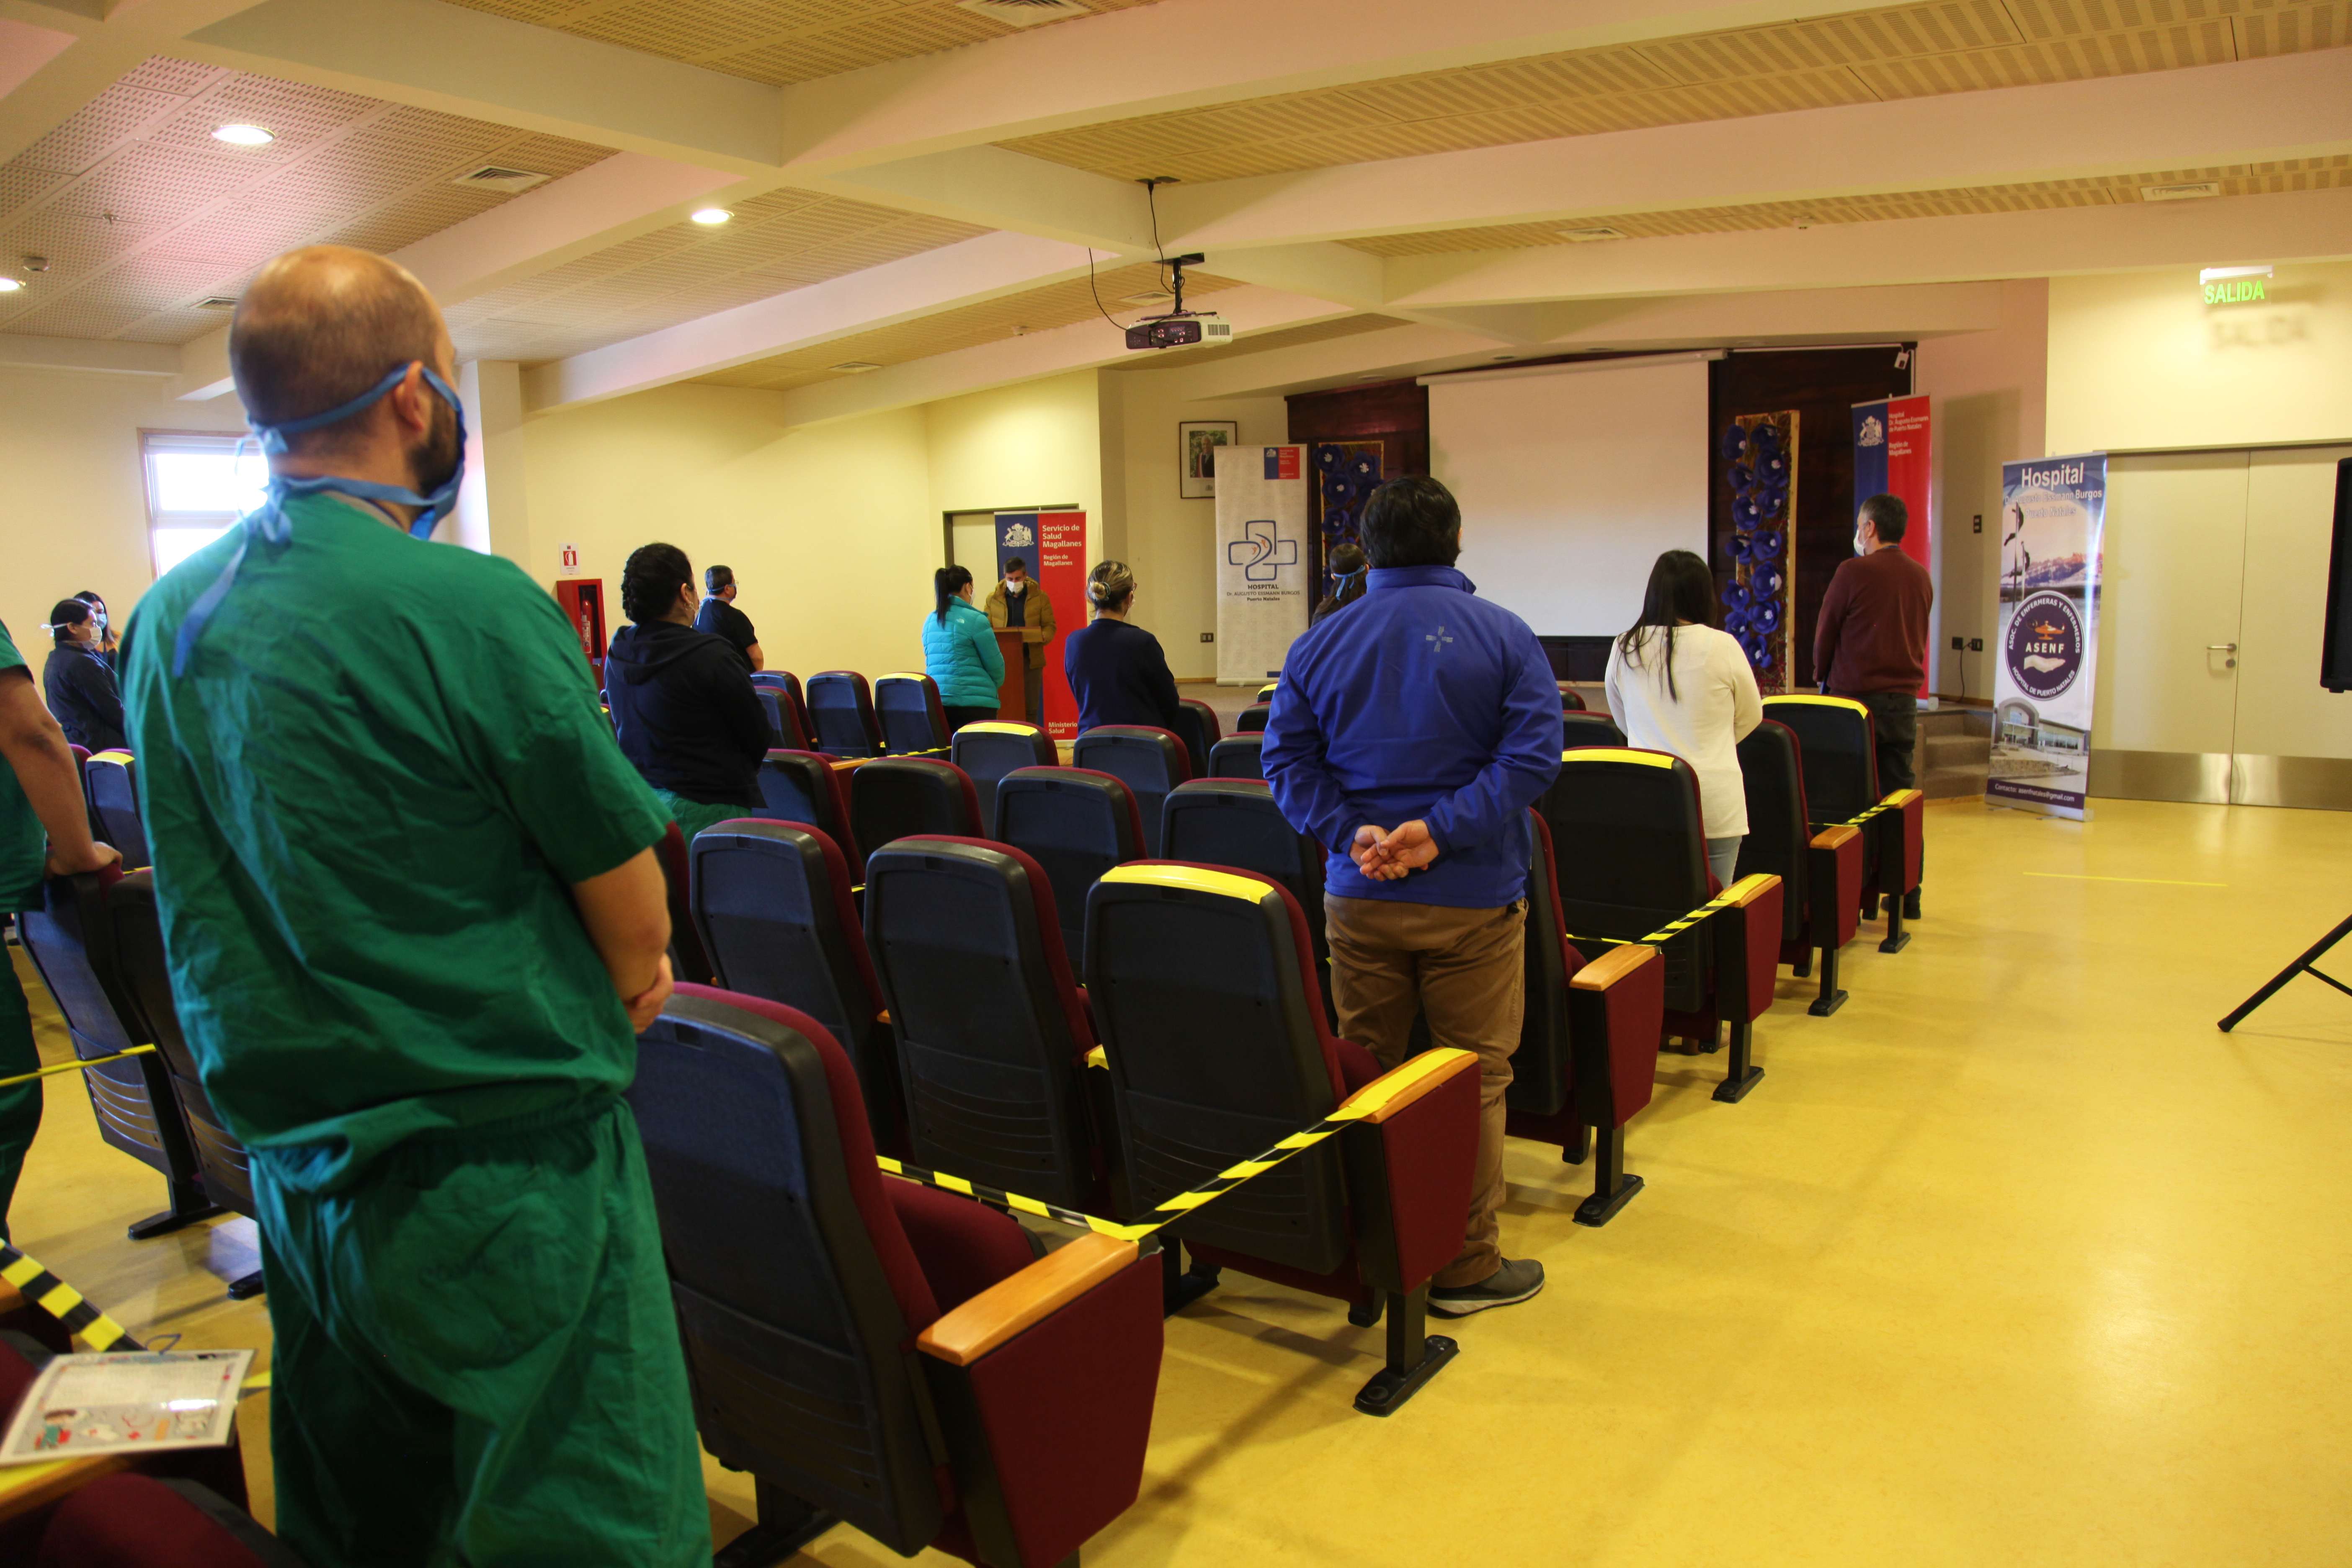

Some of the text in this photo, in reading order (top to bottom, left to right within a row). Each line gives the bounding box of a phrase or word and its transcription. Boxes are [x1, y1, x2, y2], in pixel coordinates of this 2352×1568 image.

[2204, 281, 2265, 304] SALIDA
[2022, 462, 2084, 491] Hospital
[2042, 492, 2074, 502] Essmann
[2075, 489, 2102, 501] Burgos
[2025, 506, 2076, 518] Puerto Natales
[2014, 615, 2022, 627] DE
[2021, 598, 2058, 617] ENFERMERAS
[2063, 605, 2080, 653] ENFERMEROS
[2025, 642, 2065, 653] ASENF
[2012, 666, 2075, 696] HOSPITAL DE PUERTO NATALES
[1995, 783, 2017, 793] Contacto:
